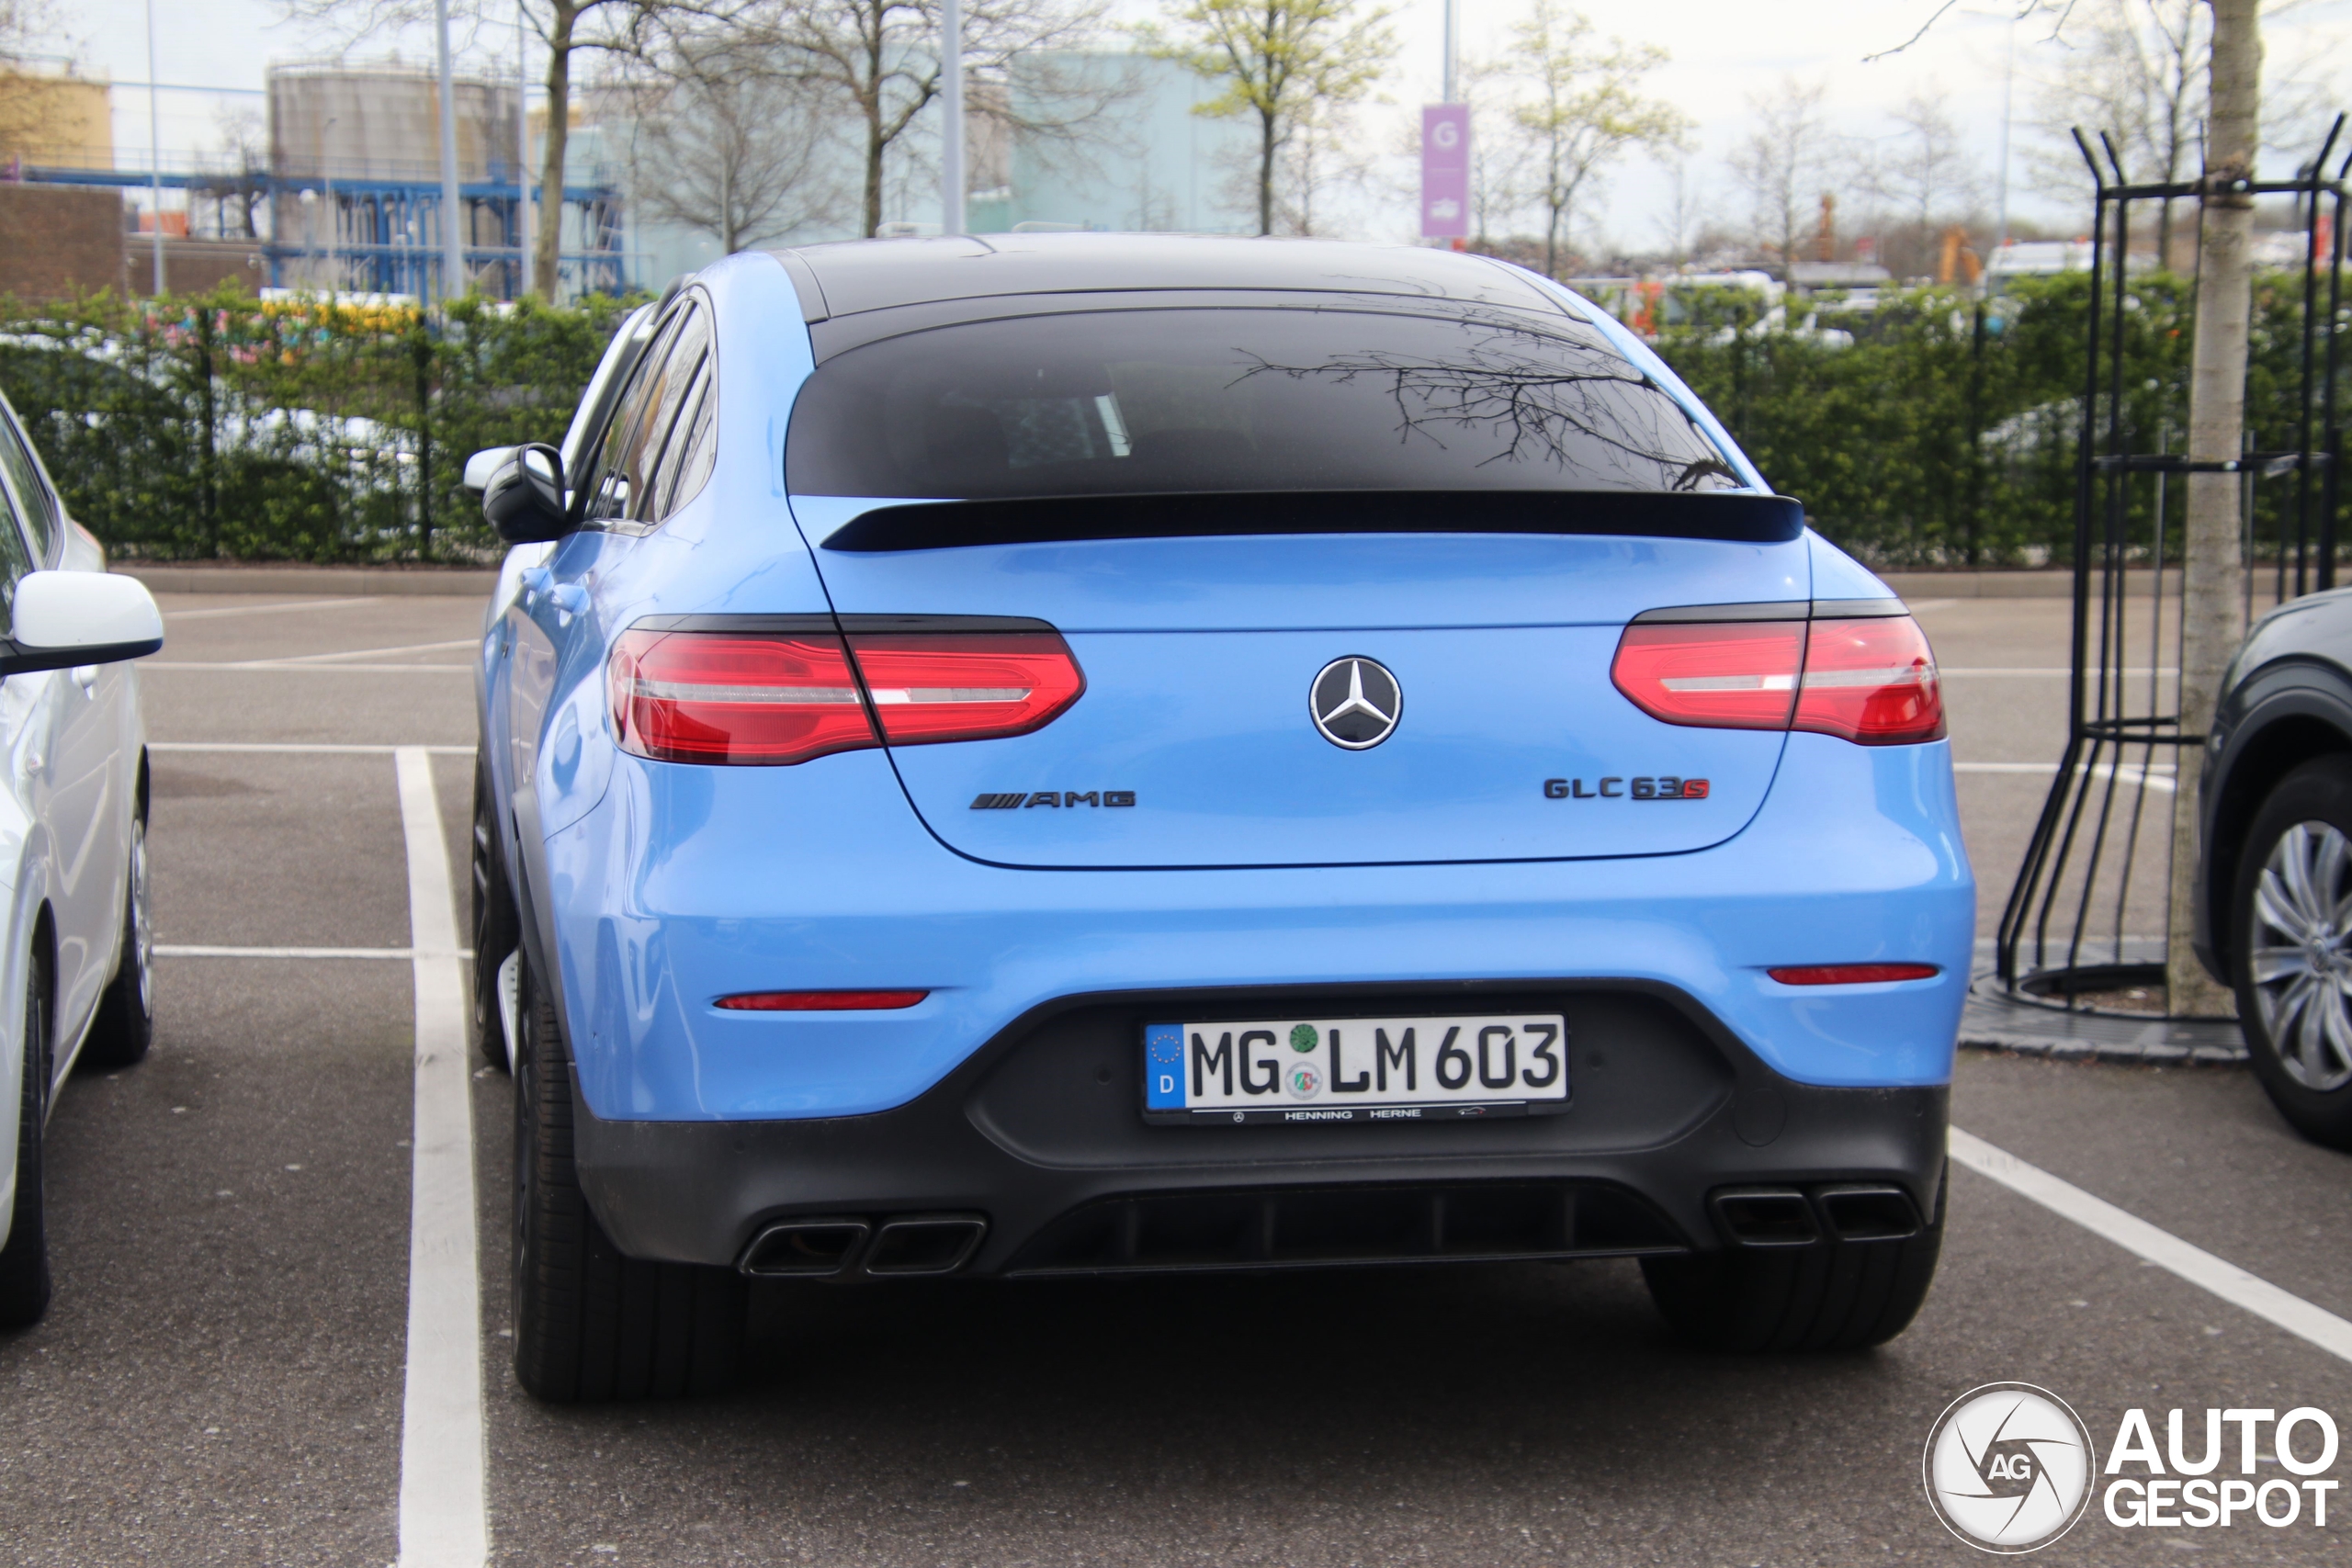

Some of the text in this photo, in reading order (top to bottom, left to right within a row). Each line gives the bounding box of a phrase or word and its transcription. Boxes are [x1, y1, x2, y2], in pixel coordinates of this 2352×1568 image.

[1432, 120, 1459, 148] G
[1544, 777, 1623, 798] GLC
[1192, 1029, 1280, 1097] MG
[1329, 1027, 1417, 1092] LM
[1435, 1023, 1559, 1090] 603
[1159, 1075, 1174, 1094] D
[1284, 1109, 1421, 1121] HENNING HERNE
